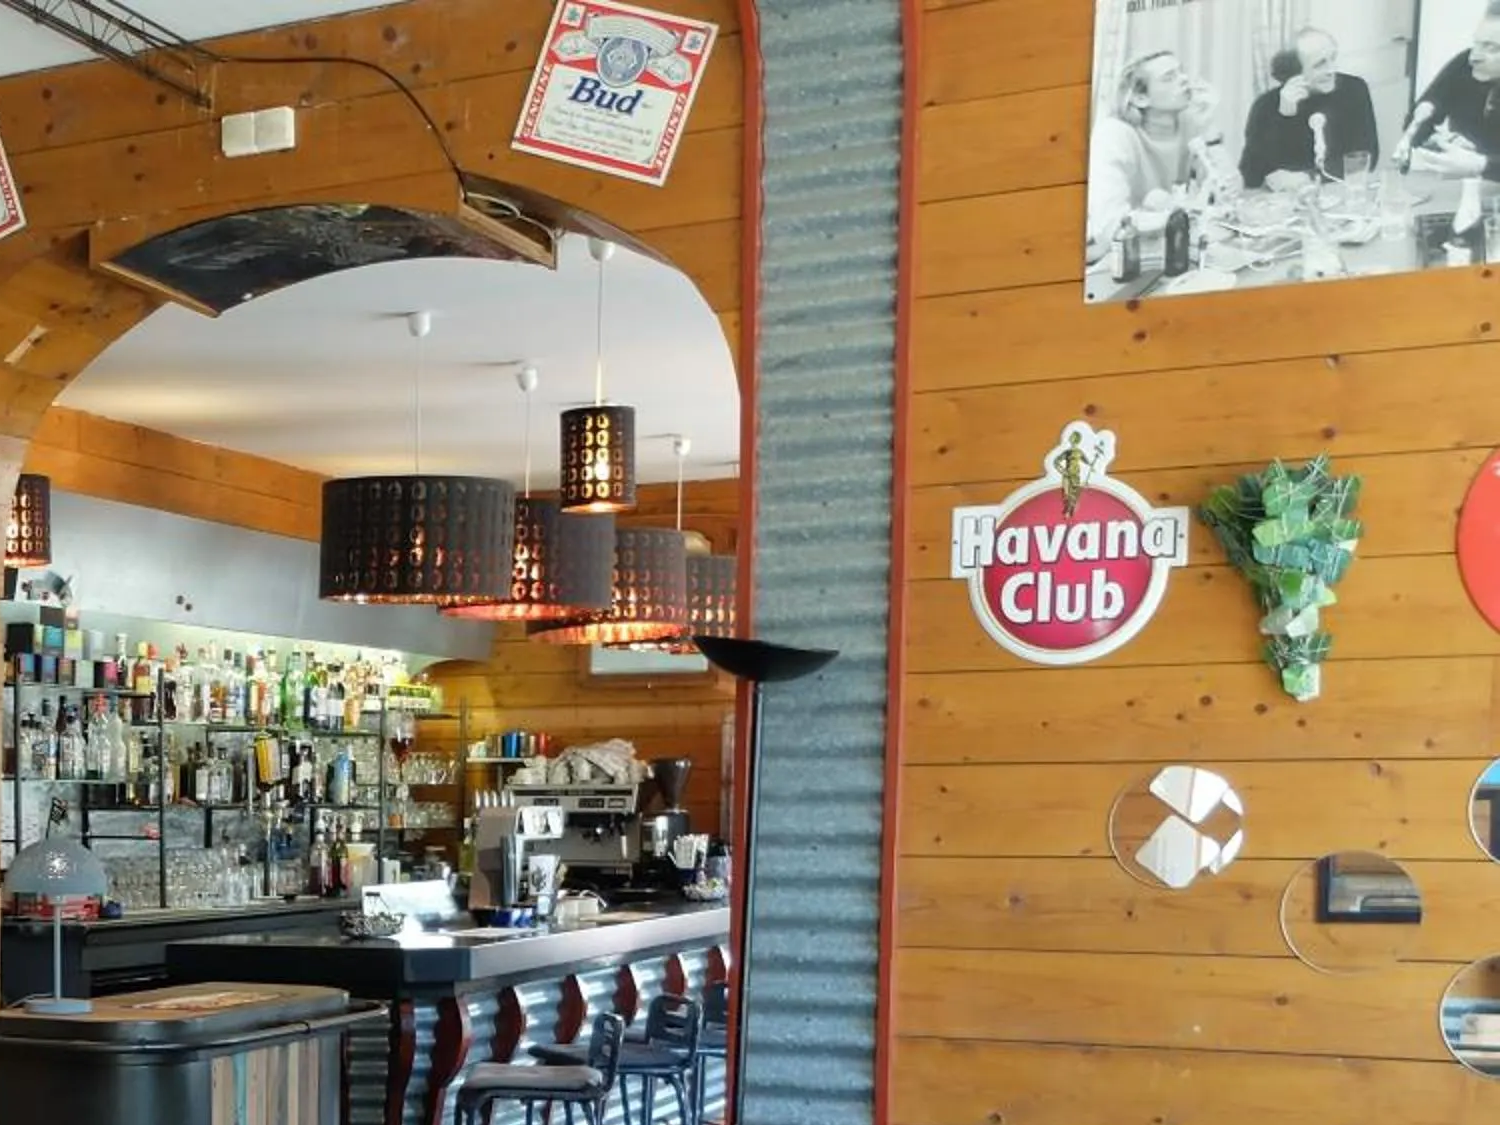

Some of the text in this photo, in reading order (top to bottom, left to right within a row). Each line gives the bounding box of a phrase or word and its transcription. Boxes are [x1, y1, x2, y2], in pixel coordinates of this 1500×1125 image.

[568, 76, 643, 116] Bud
[960, 514, 1177, 568] Havana
[1000, 569, 1125, 624] Club
